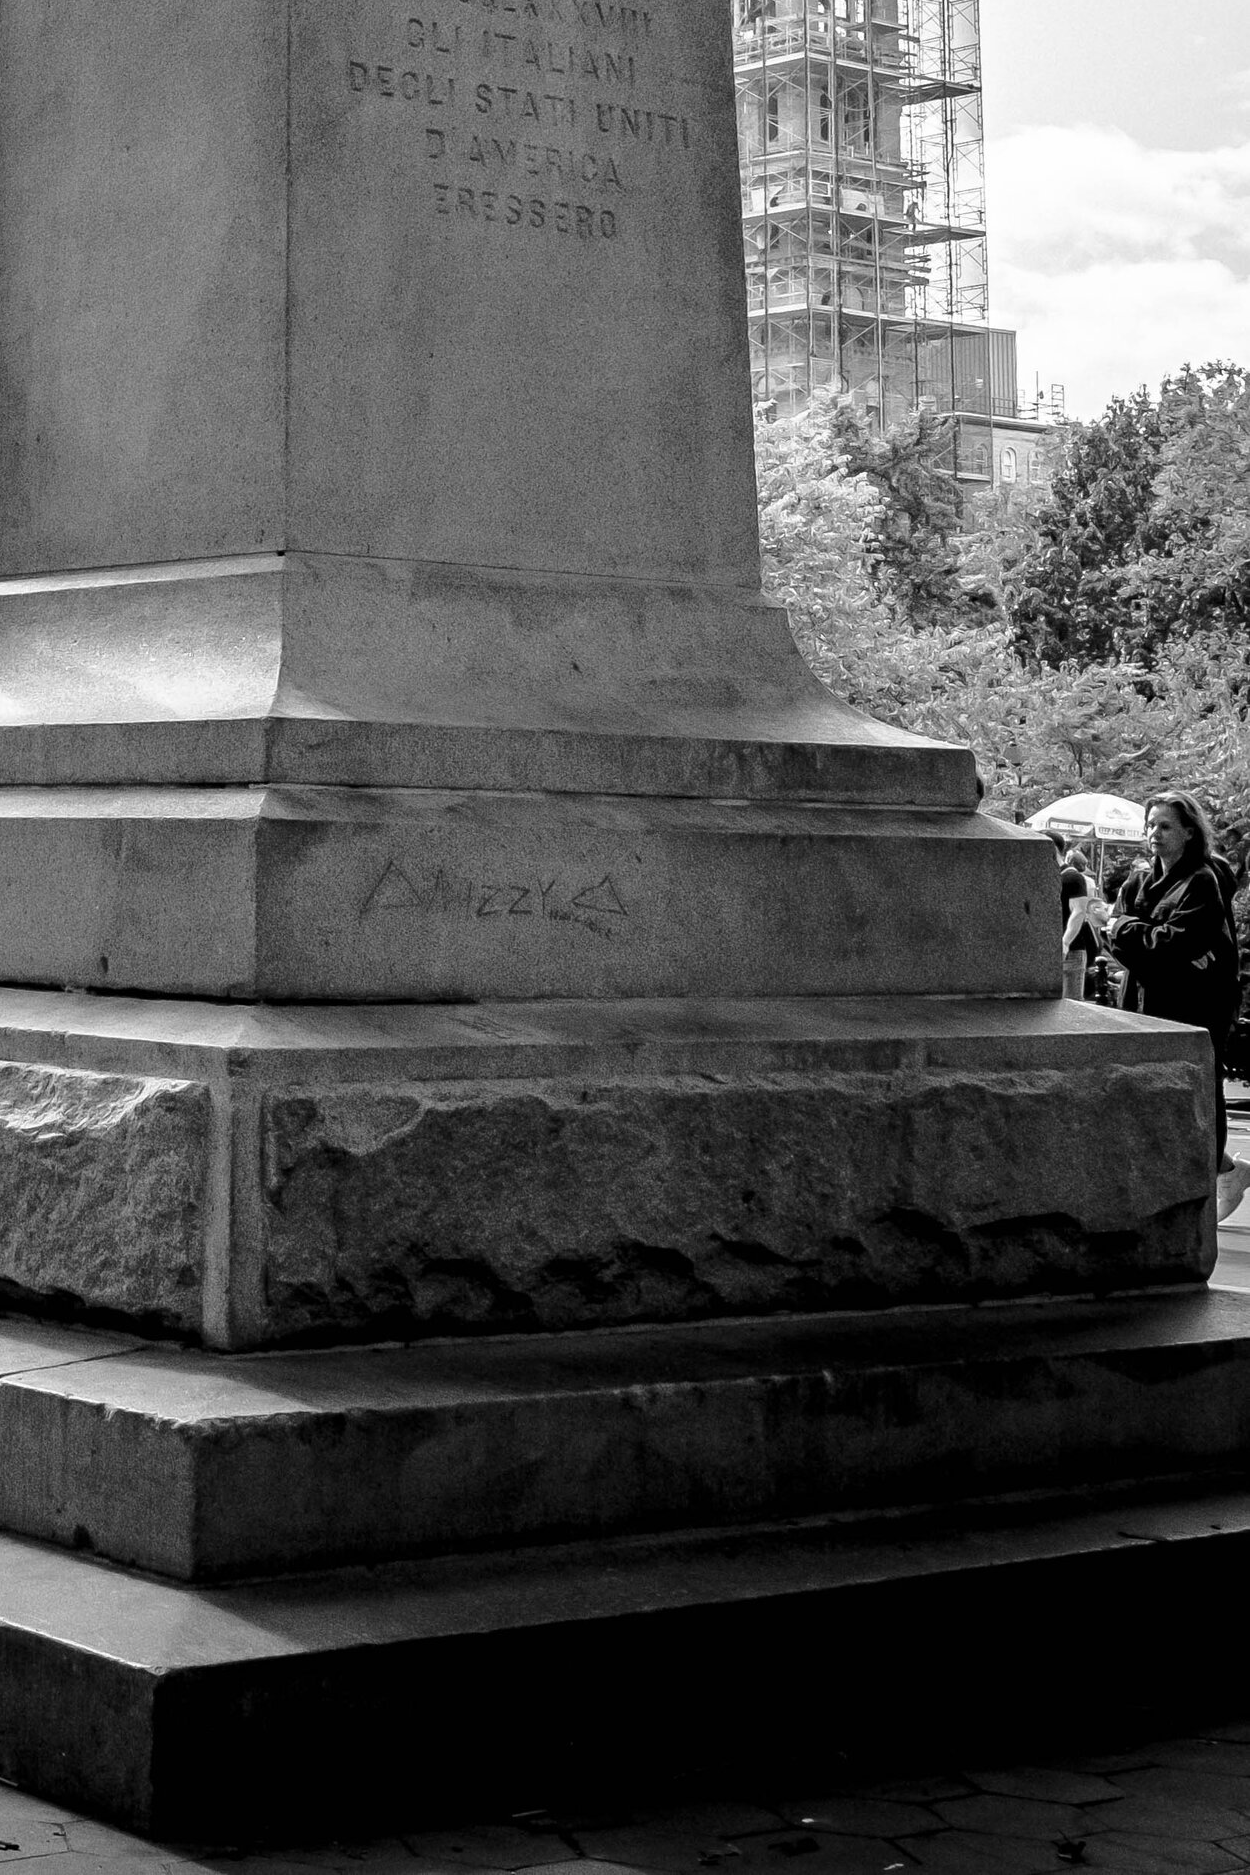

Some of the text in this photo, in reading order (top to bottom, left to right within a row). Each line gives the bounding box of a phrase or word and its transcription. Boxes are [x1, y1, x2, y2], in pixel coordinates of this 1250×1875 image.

[407, 17, 636, 87] GLI ITALIANI
[349, 60, 691, 150] DEGLI STATI UNITI
[432, 183, 618, 240] ERESSERO
